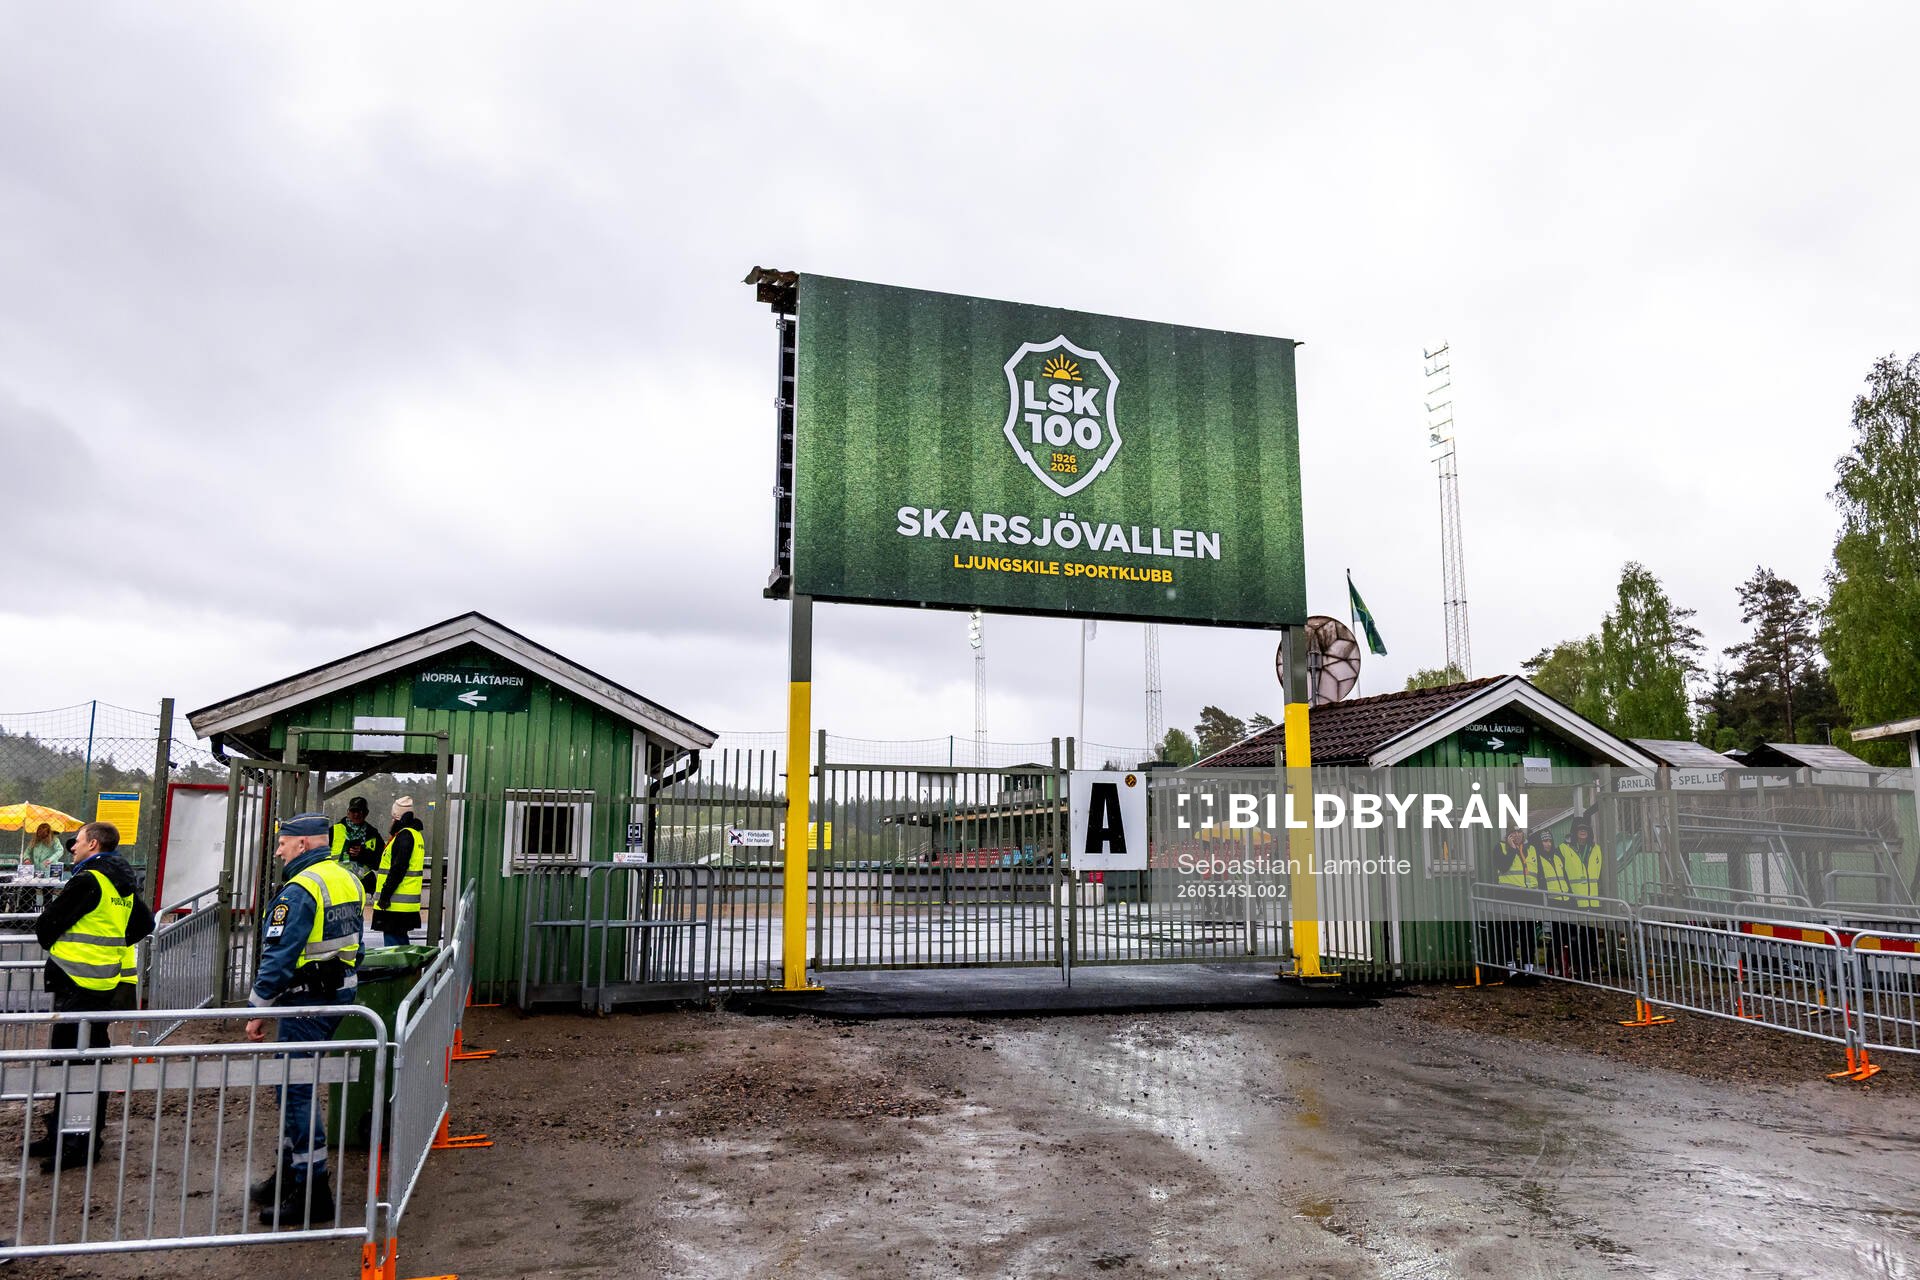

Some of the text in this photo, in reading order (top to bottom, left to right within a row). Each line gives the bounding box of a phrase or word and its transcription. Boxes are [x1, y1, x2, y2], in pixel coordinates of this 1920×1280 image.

[1024, 380, 1101, 417] LSK
[1024, 412, 1102, 450] 100
[1050, 462, 1078, 473] 2026
[1051, 453, 1076, 464] 1926
[896, 506, 1221, 560] SKARSJÖVALLEN
[954, 554, 1173, 583] LJUNGSKILE SPORTKLUBB
[422, 672, 524, 687] NORRA LÄKTAREN
[1489, 723, 1525, 733] LÄKTAREN
[1085, 782, 1127, 855] A
